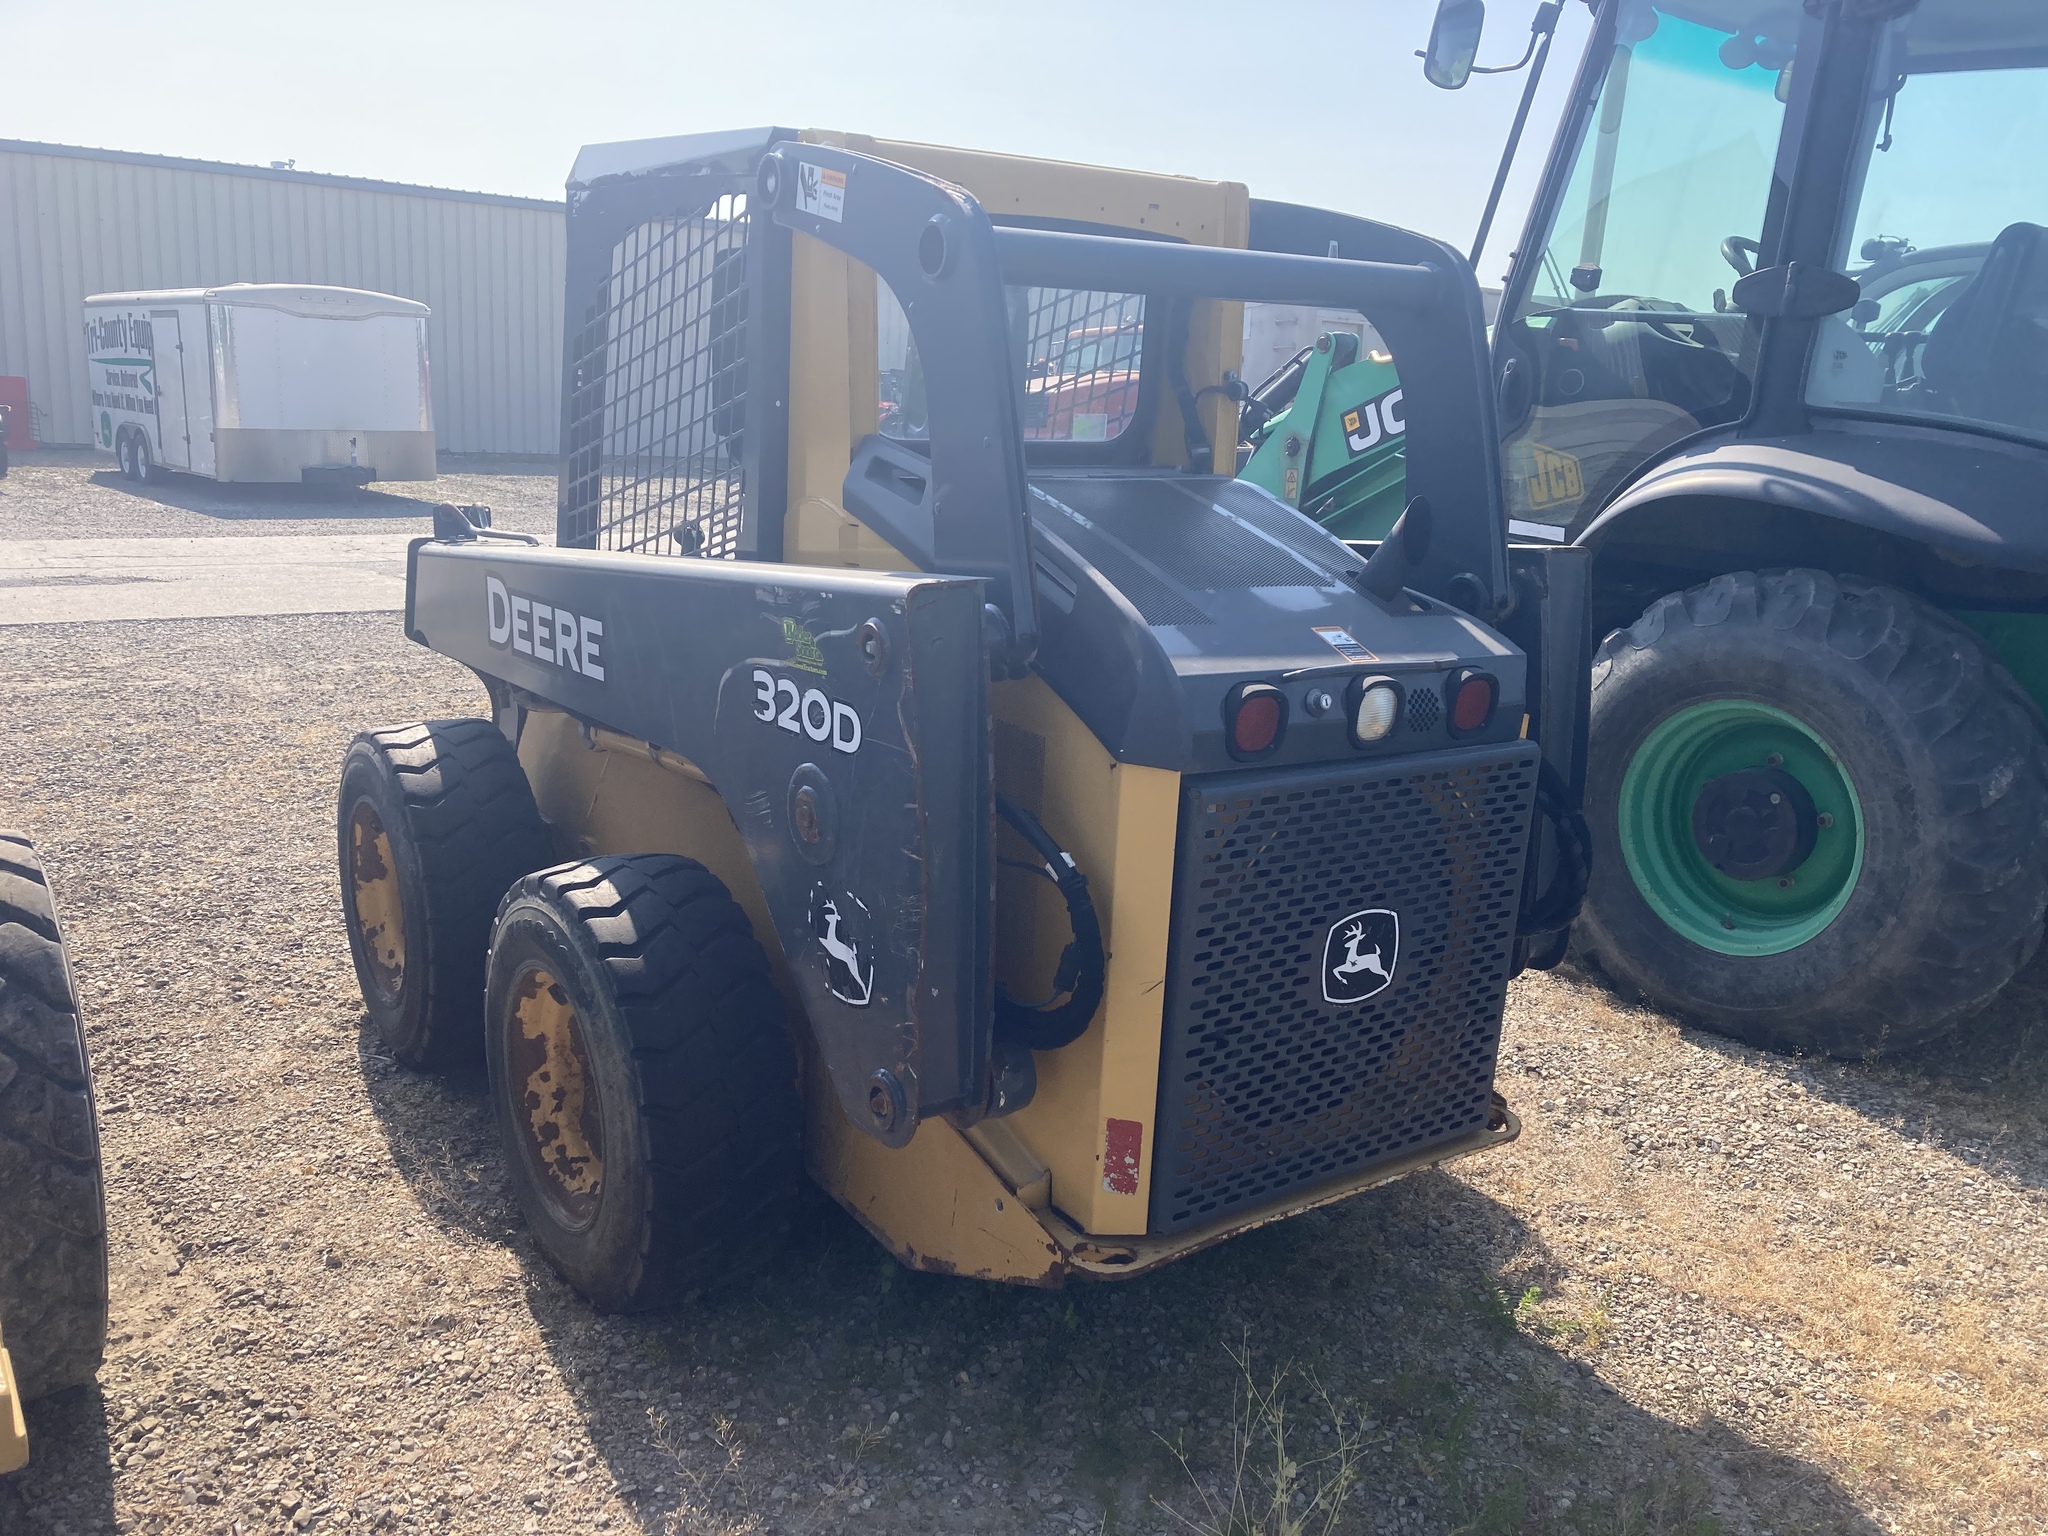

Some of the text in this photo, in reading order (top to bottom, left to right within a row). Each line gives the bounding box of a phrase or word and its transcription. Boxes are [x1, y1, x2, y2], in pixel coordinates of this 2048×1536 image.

[86, 314, 127, 355] Tri-County
[1349, 389, 1406, 451] JC
[1531, 447, 1581, 503] JCB
[487, 577, 605, 682] DEERE
[753, 669, 862, 754] 320D
